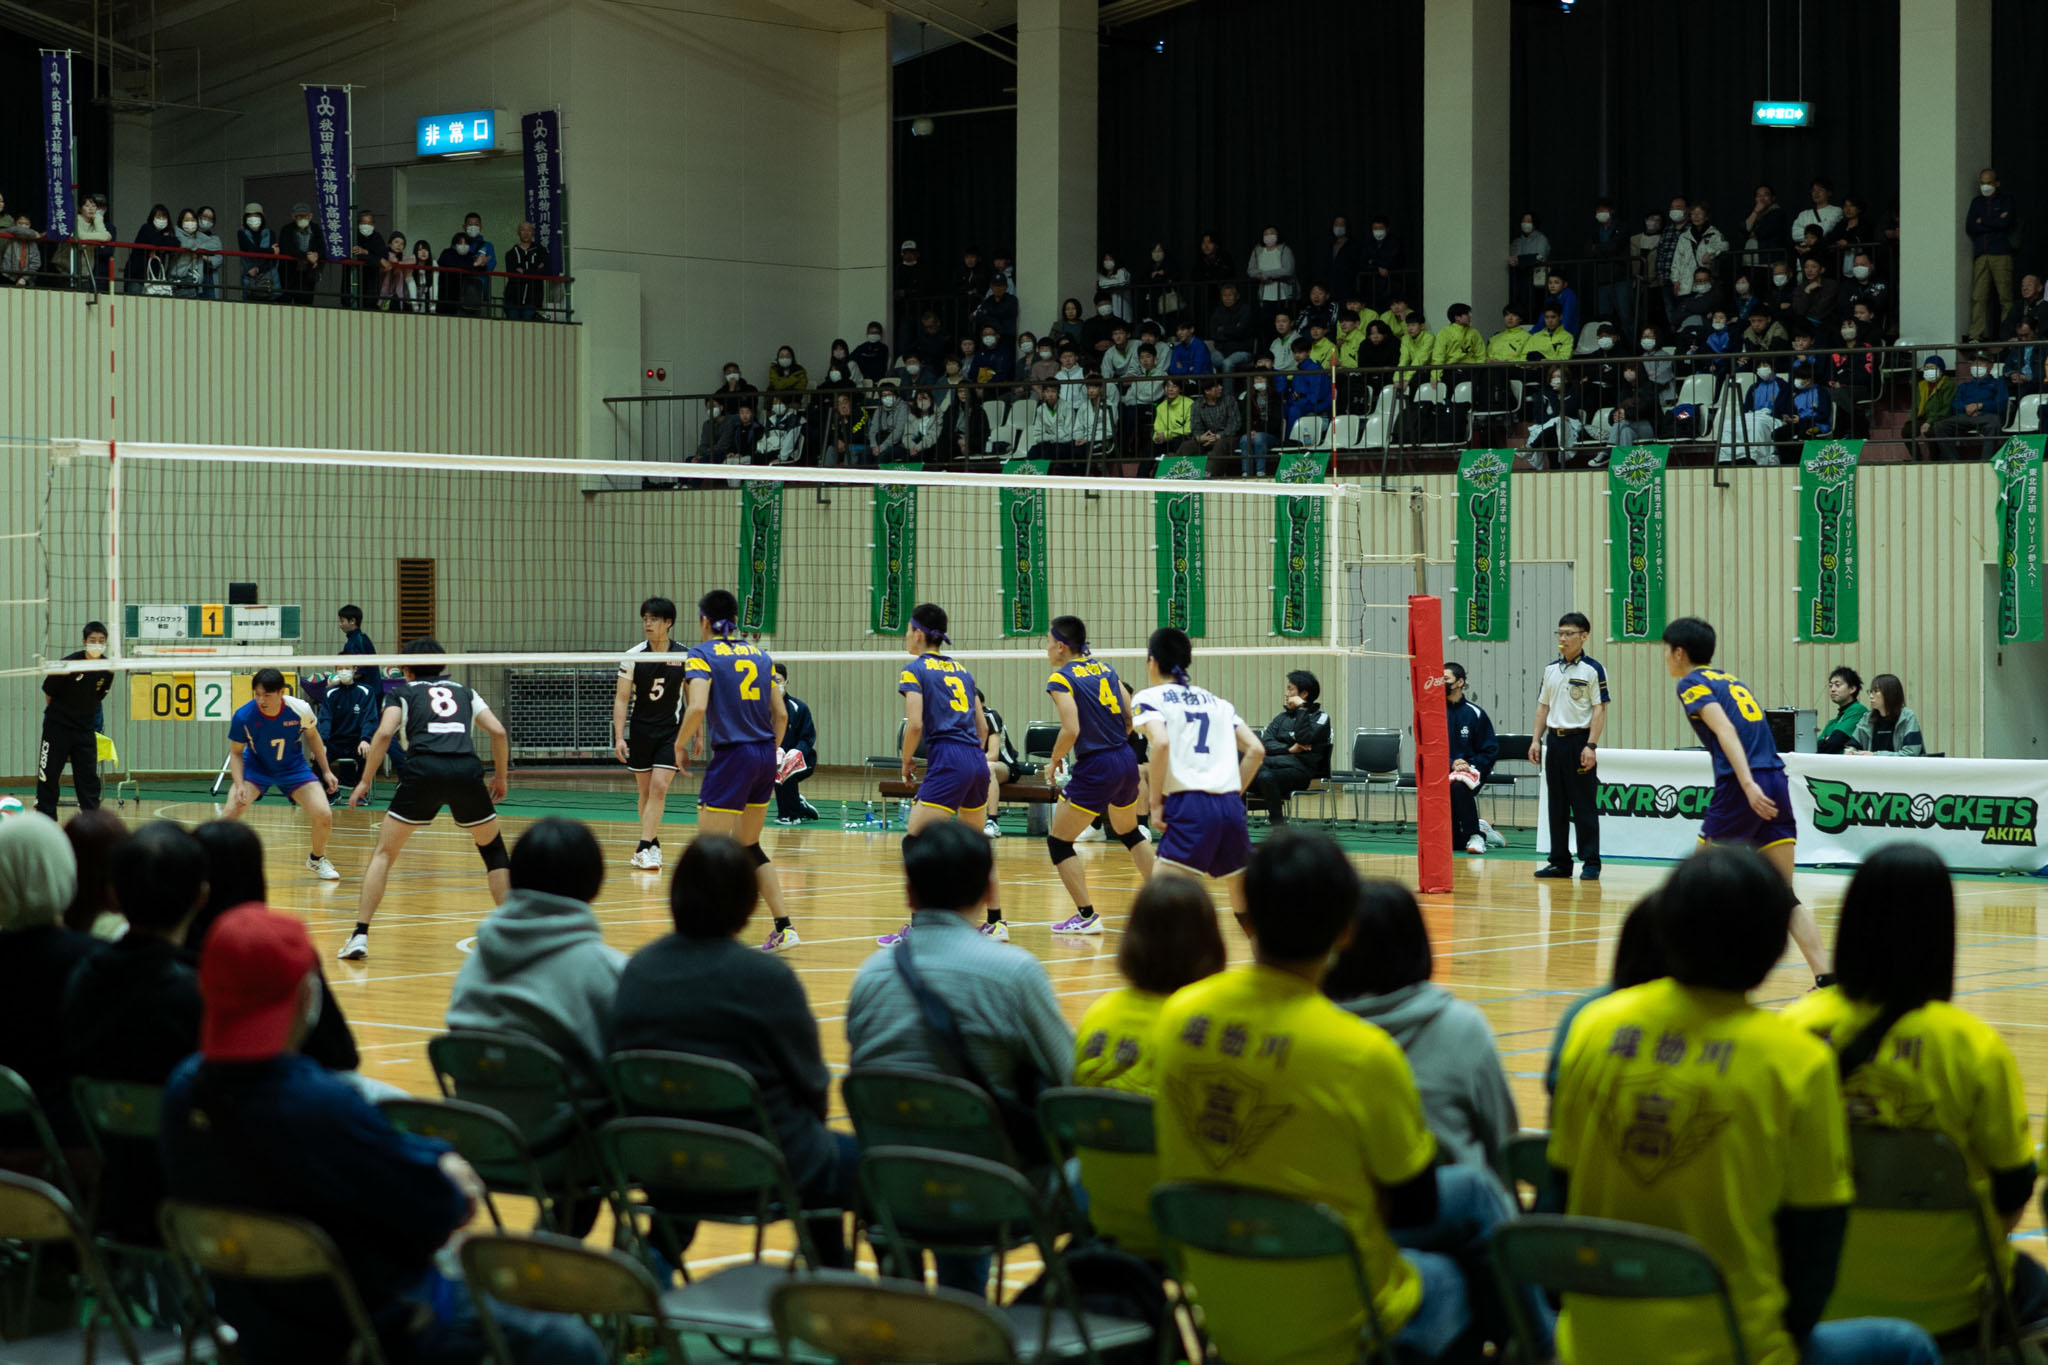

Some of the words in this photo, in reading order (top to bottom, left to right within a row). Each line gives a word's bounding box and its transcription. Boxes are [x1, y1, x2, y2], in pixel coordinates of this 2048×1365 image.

[425, 119, 488, 146] 非常口
[51, 87, 70, 236] 秋田県立雄物川高等学校
[319, 119, 347, 257] 秋田県立雄物川高等学校
[534, 141, 551, 253] 秋田県立雄物川高等
[1499, 481, 1507, 523] 東北男子初
[1654, 476, 1662, 520] 東北男子初
[2028, 468, 2037, 513] 東北男子初
[1471, 488, 1498, 634] SKYROCKETS
[1624, 484, 1652, 636] SKYROCKETS
[1816, 481, 1846, 637] SKYROCKETS
[208, 612, 216, 633] 1
[1626, 602, 1634, 632] AKITA
[1814, 602, 1823, 633] AKITA
[649, 678, 666, 701] 5
[735, 659, 761, 700] 2
[944, 675, 969, 713] 3
[1099, 677, 1122, 714] 4
[204, 683, 223, 717] 2
[428, 687, 458, 718] 8
[1728, 684, 1763, 722] 8
[270, 738, 285, 761] 7
[1184, 711, 1210, 754] 7
[1596, 784, 1715, 818] KYROCK
[1804, 775, 2038, 834] SKYROCKETS
[1985, 826, 2033, 842] AKITA
